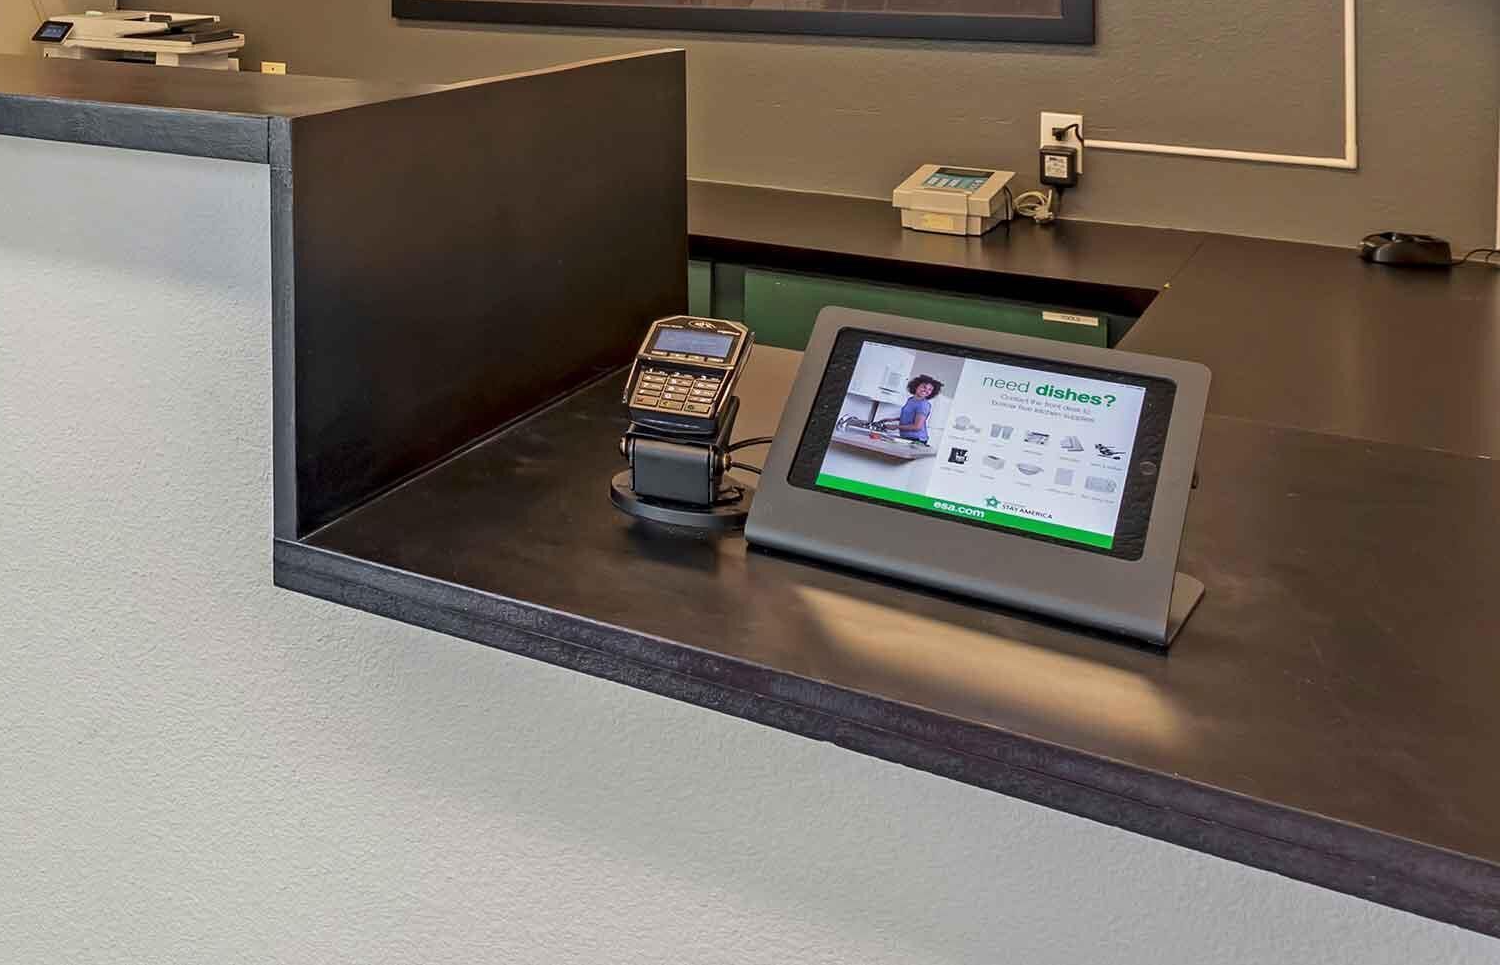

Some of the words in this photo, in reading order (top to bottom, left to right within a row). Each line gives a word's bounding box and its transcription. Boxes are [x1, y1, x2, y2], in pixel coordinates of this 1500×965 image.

[982, 376, 1030, 393] need
[1035, 384, 1116, 407] dishes?
[933, 500, 985, 519] esa.com
[1002, 504, 1018, 512] STAY
[1020, 508, 1053, 520] AMERICA
